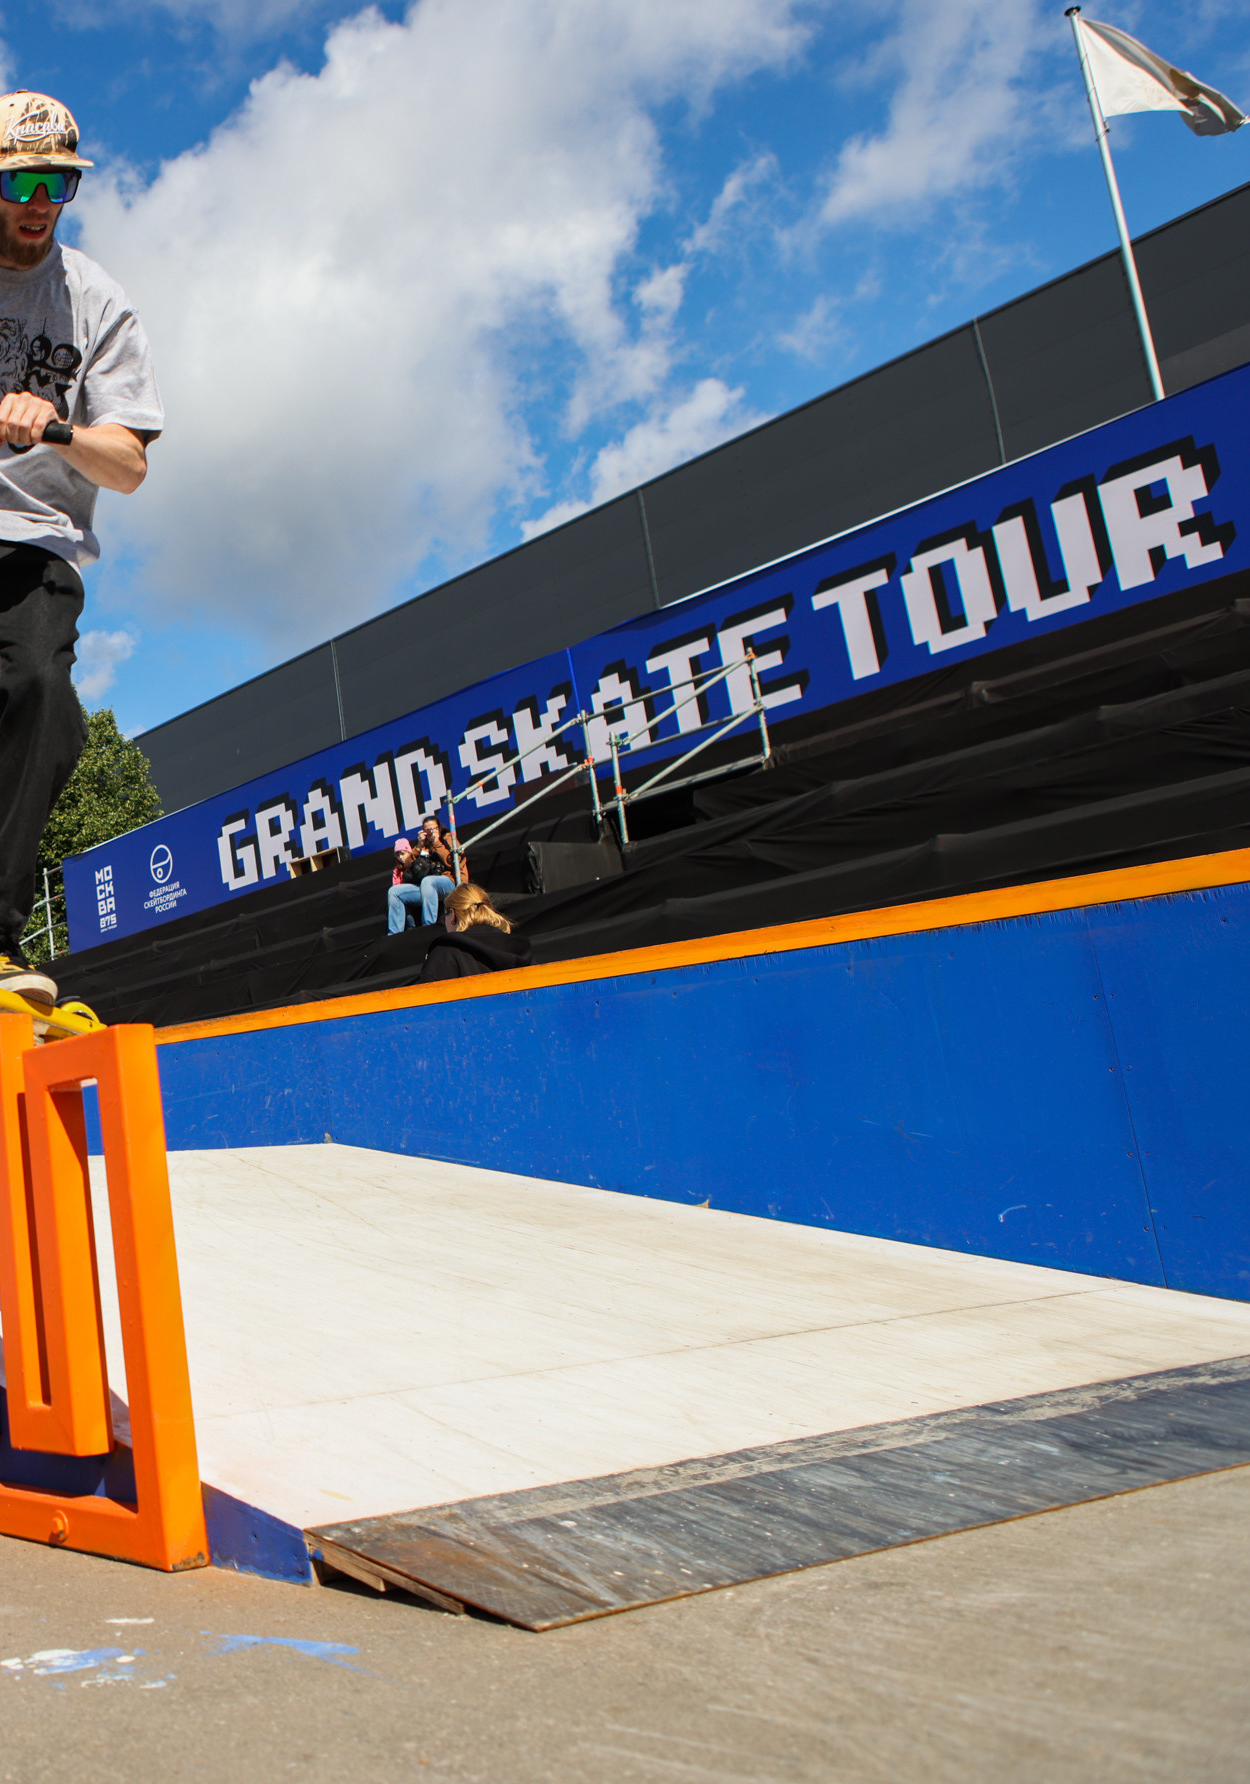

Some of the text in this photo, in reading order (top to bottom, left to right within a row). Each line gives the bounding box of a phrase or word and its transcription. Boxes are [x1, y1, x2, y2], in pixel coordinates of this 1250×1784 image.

[217, 454, 1224, 891] GRAND SKATE TOUR
[143, 888, 188, 910] СКЕЙТБОРДИНГА
[149, 881, 180, 898] ФЕДЕРАЦИЯ
[155, 900, 177, 914] РОССИИ
